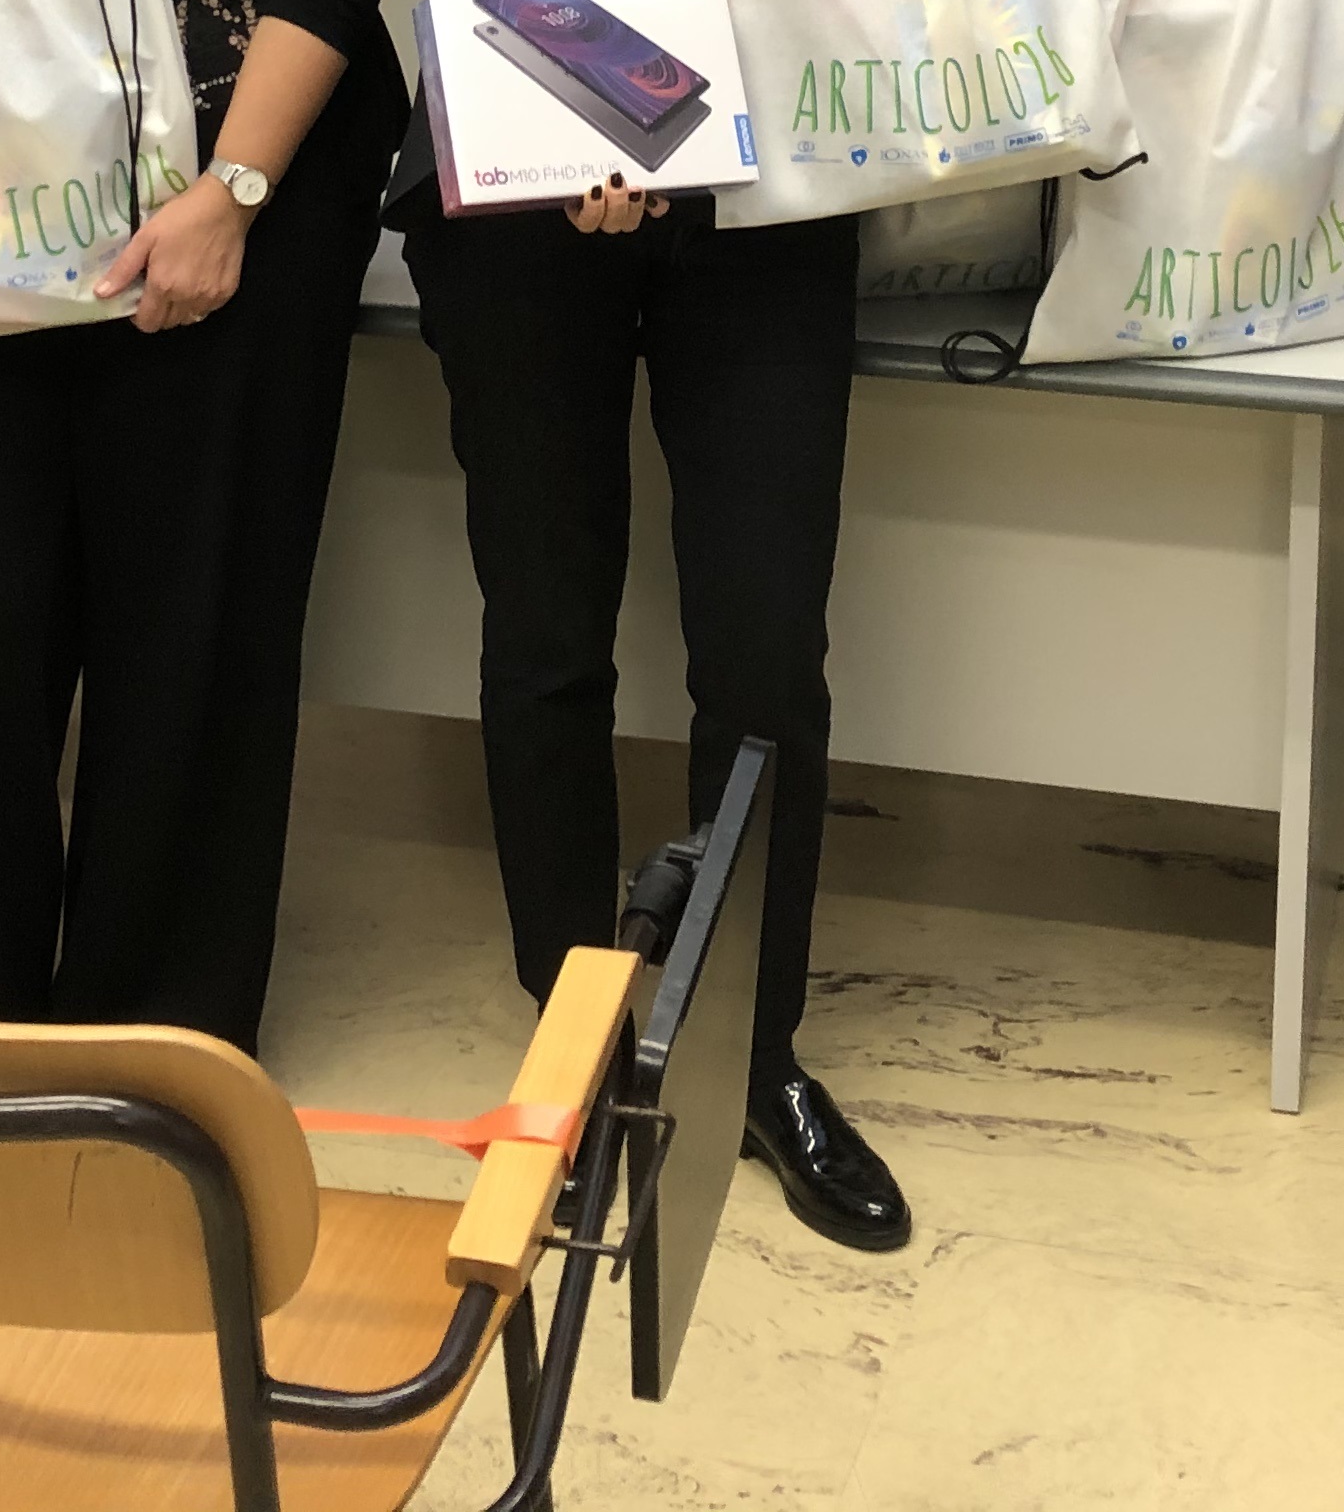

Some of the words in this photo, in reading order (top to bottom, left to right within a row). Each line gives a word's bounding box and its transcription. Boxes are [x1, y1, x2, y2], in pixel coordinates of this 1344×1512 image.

[792, 25, 1075, 135] ARTICOLO26
[739, 117, 754, 163] Lenovo
[1009, 132, 1044, 146] PRIMO
